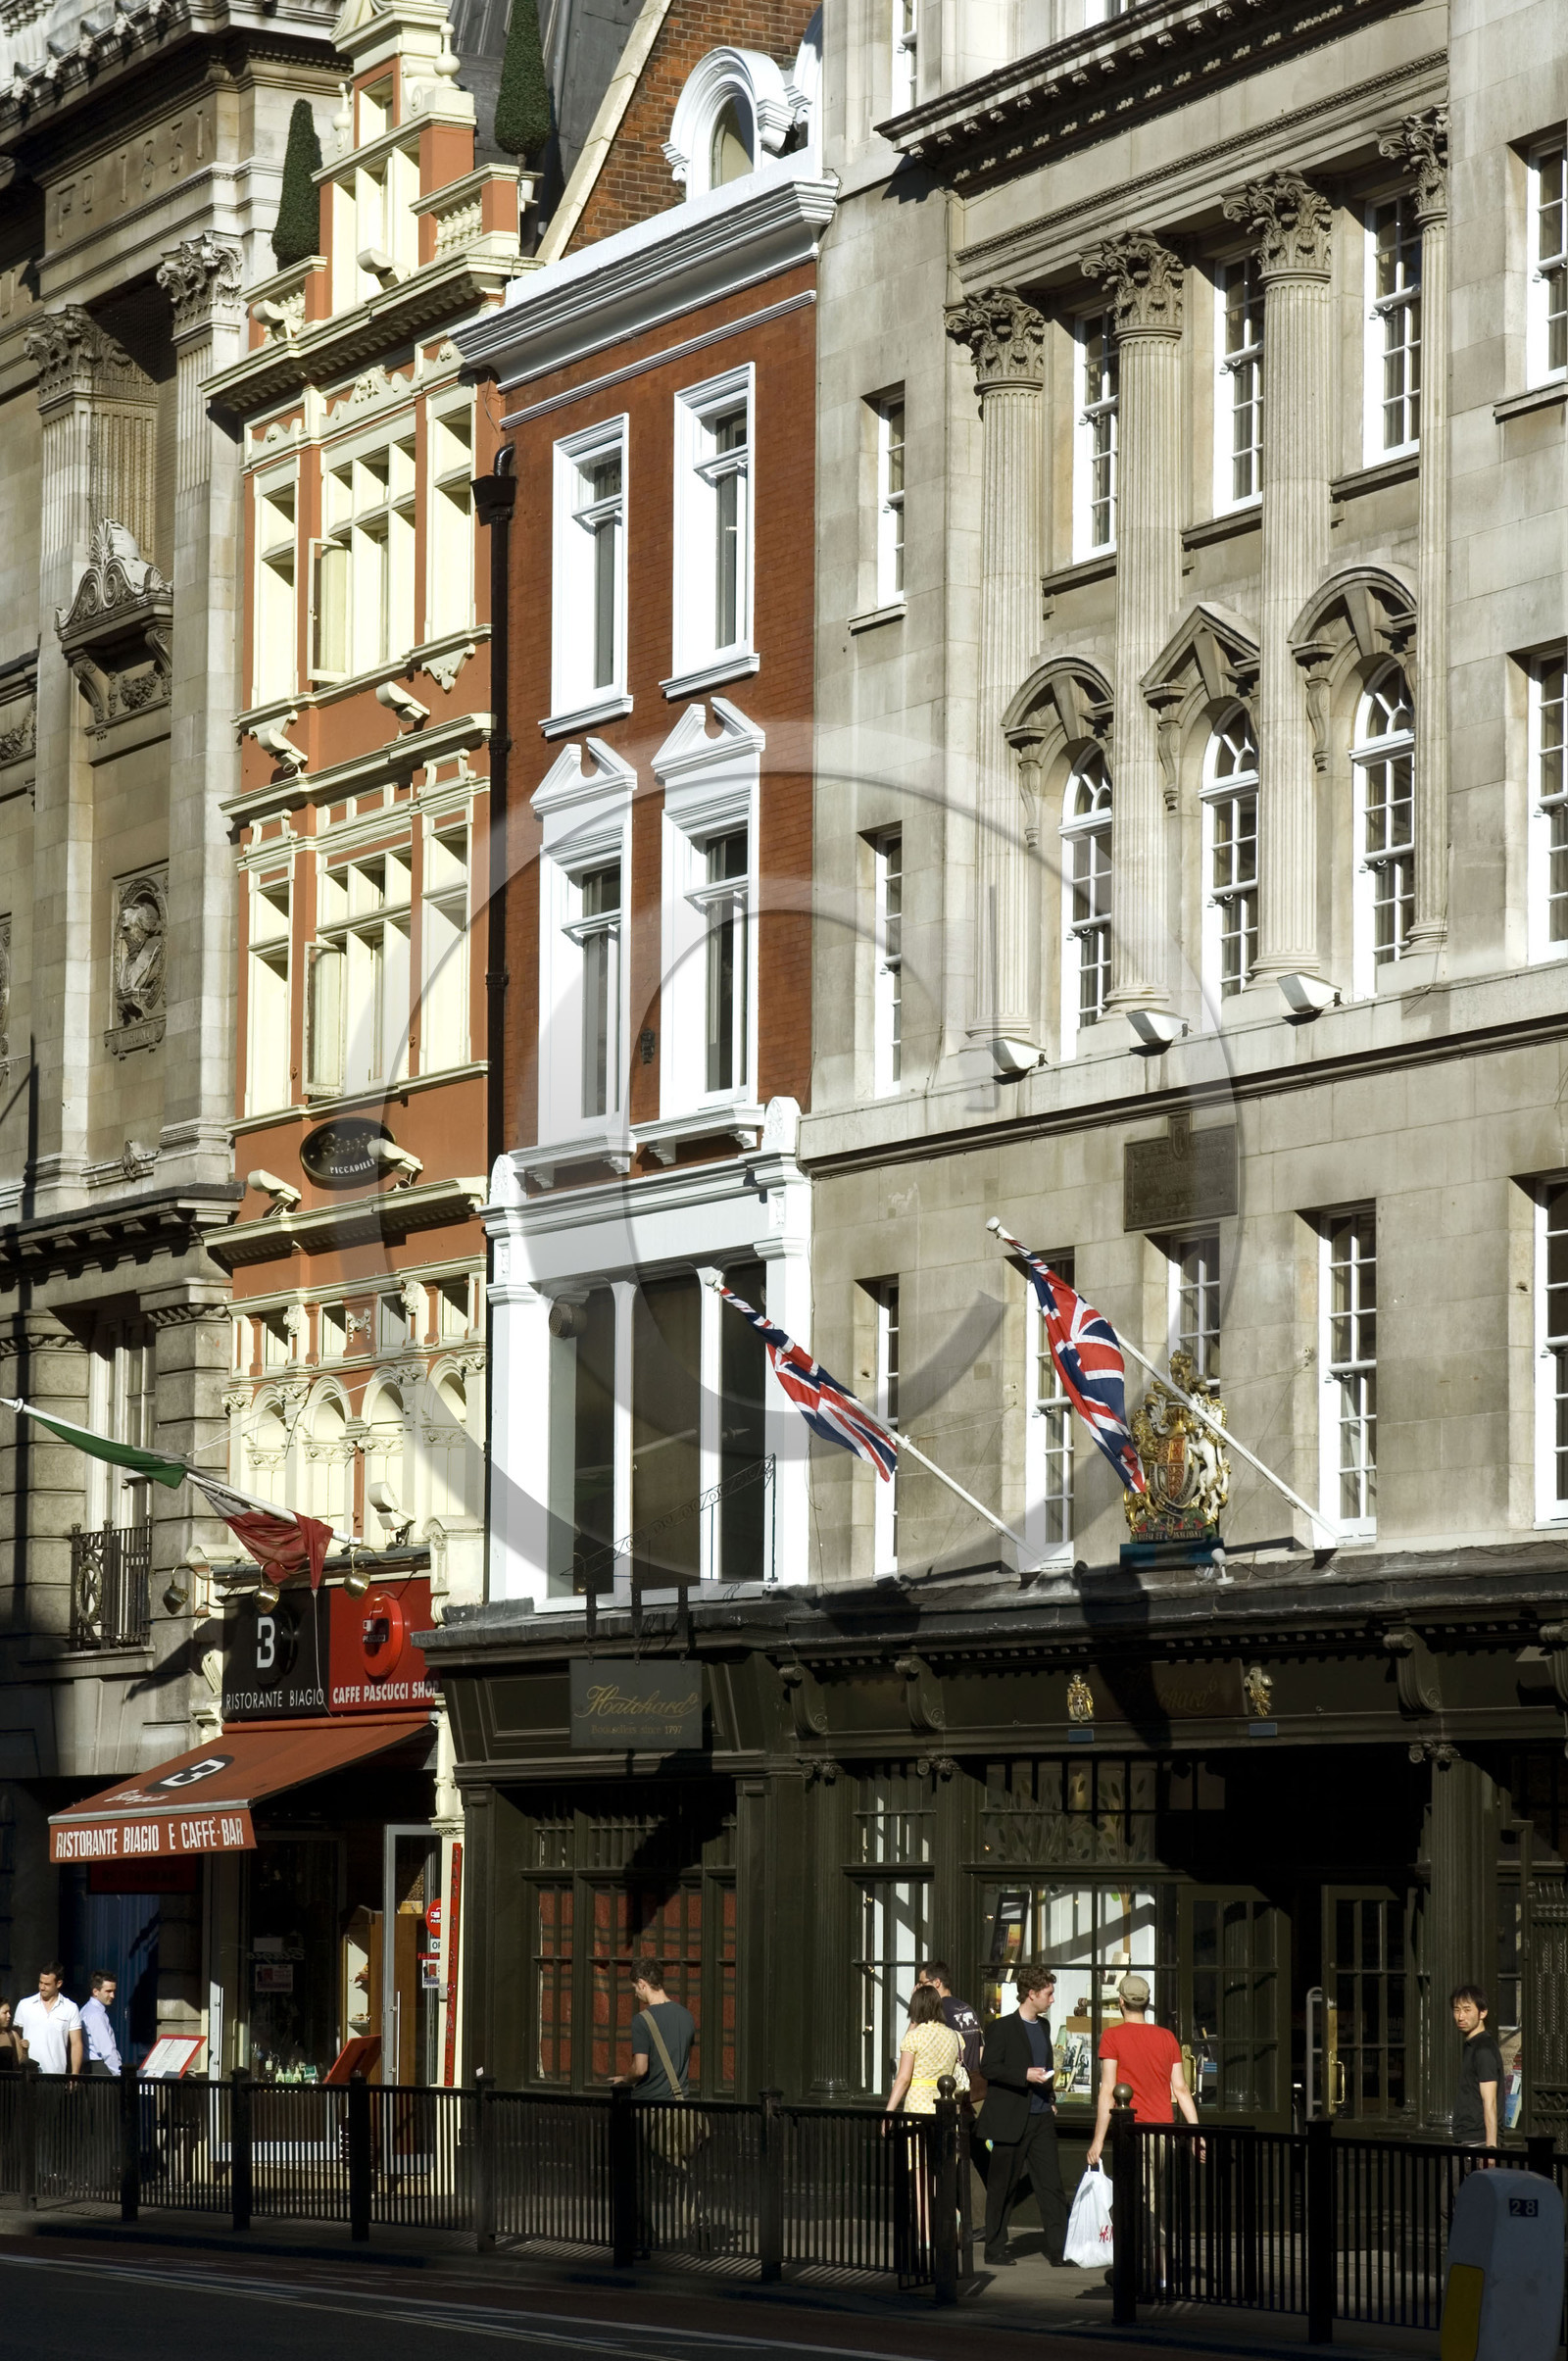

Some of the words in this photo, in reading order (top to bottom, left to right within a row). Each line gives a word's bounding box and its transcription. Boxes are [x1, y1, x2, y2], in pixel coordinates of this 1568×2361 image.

[120, 110, 204, 204] 1831
[329, 1157, 375, 1175] PICCADILLY
[225, 1691, 282, 1710] RISTORANTE
[289, 1688, 323, 1706] BIAGIO
[332, 1685, 361, 1704] CAFFE
[364, 1682, 409, 1701] PASCUCCI
[412, 1680, 440, 1698] SHOP
[664, 1725, 682, 1735] 1797
[56, 1828, 119, 1858] RISTORANTE
[122, 1824, 160, 1853] BIAGIO
[168, 1822, 176, 1850] E
[1511, 2200, 1536, 2216] 28
